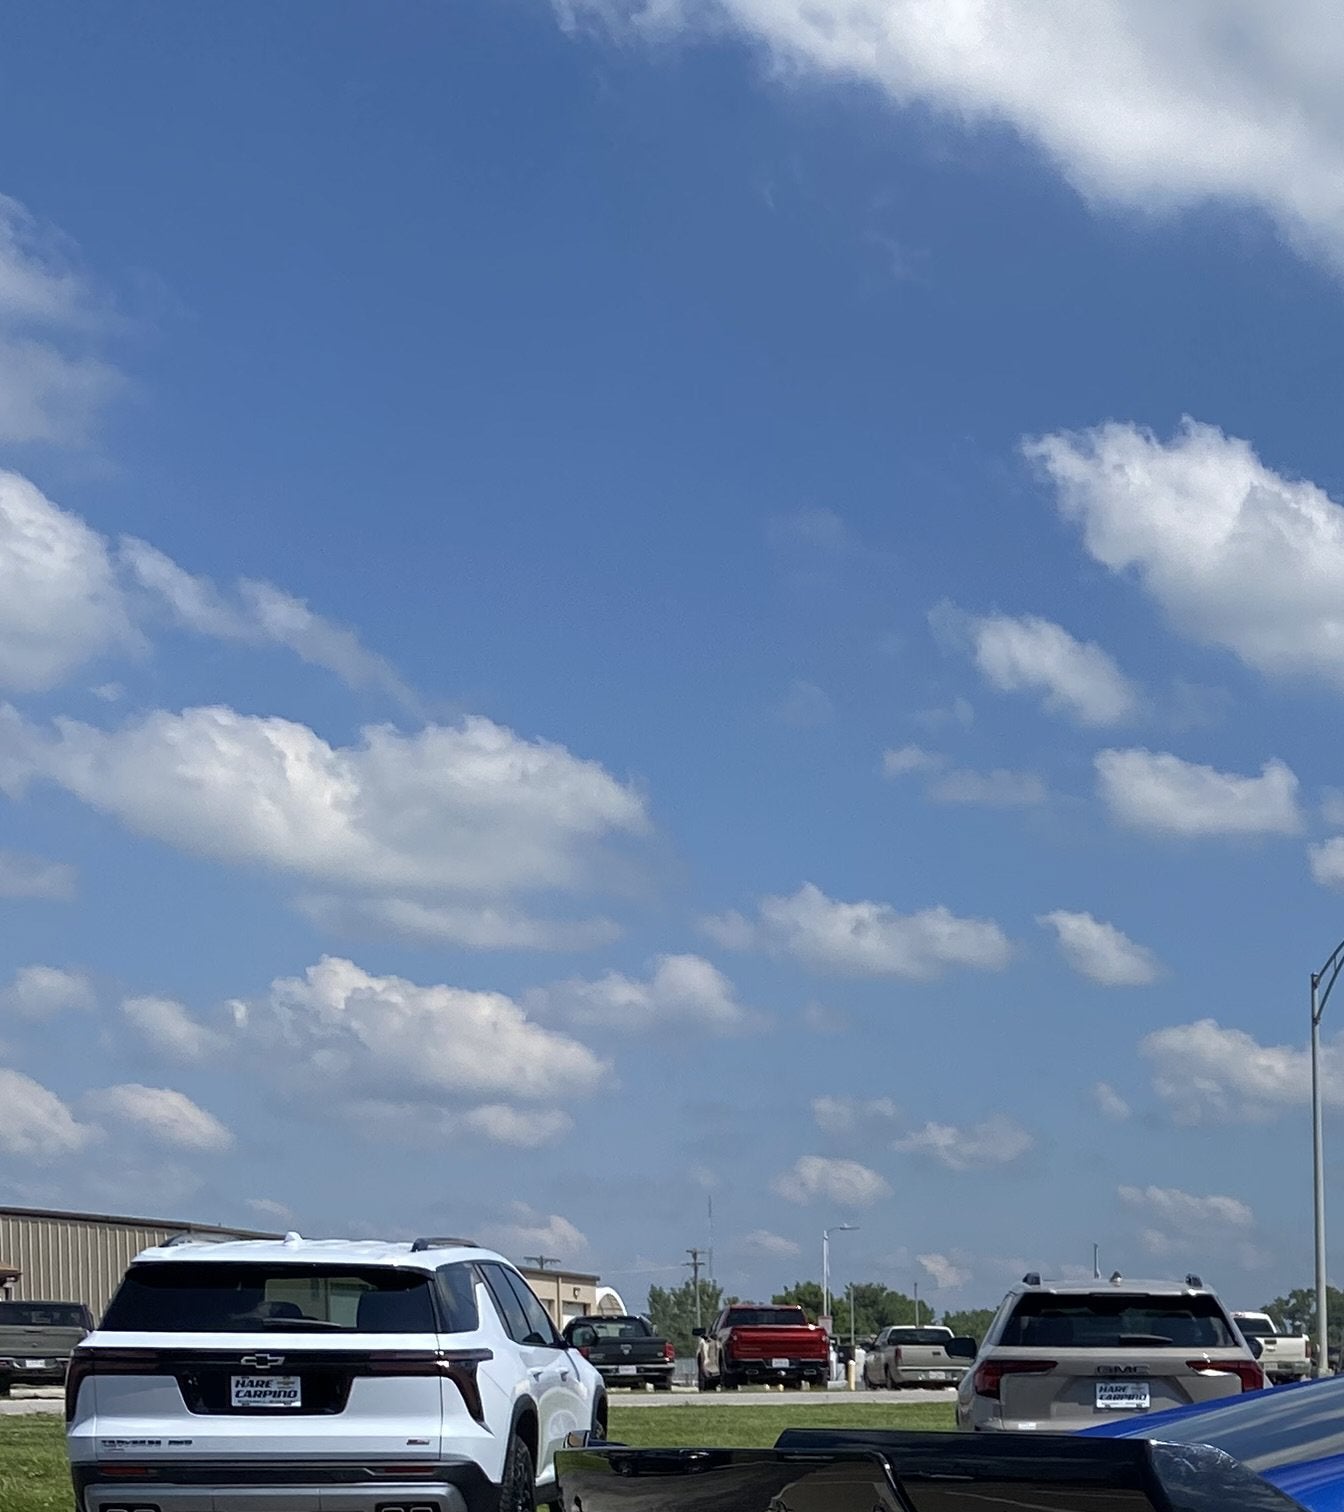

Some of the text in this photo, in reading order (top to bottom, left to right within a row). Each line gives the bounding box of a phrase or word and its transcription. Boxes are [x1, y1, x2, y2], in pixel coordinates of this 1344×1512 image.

[1097, 1365, 1151, 1376] GMC
[234, 1380, 273, 1389] HARE
[234, 1389, 299, 1399] CARPINO
